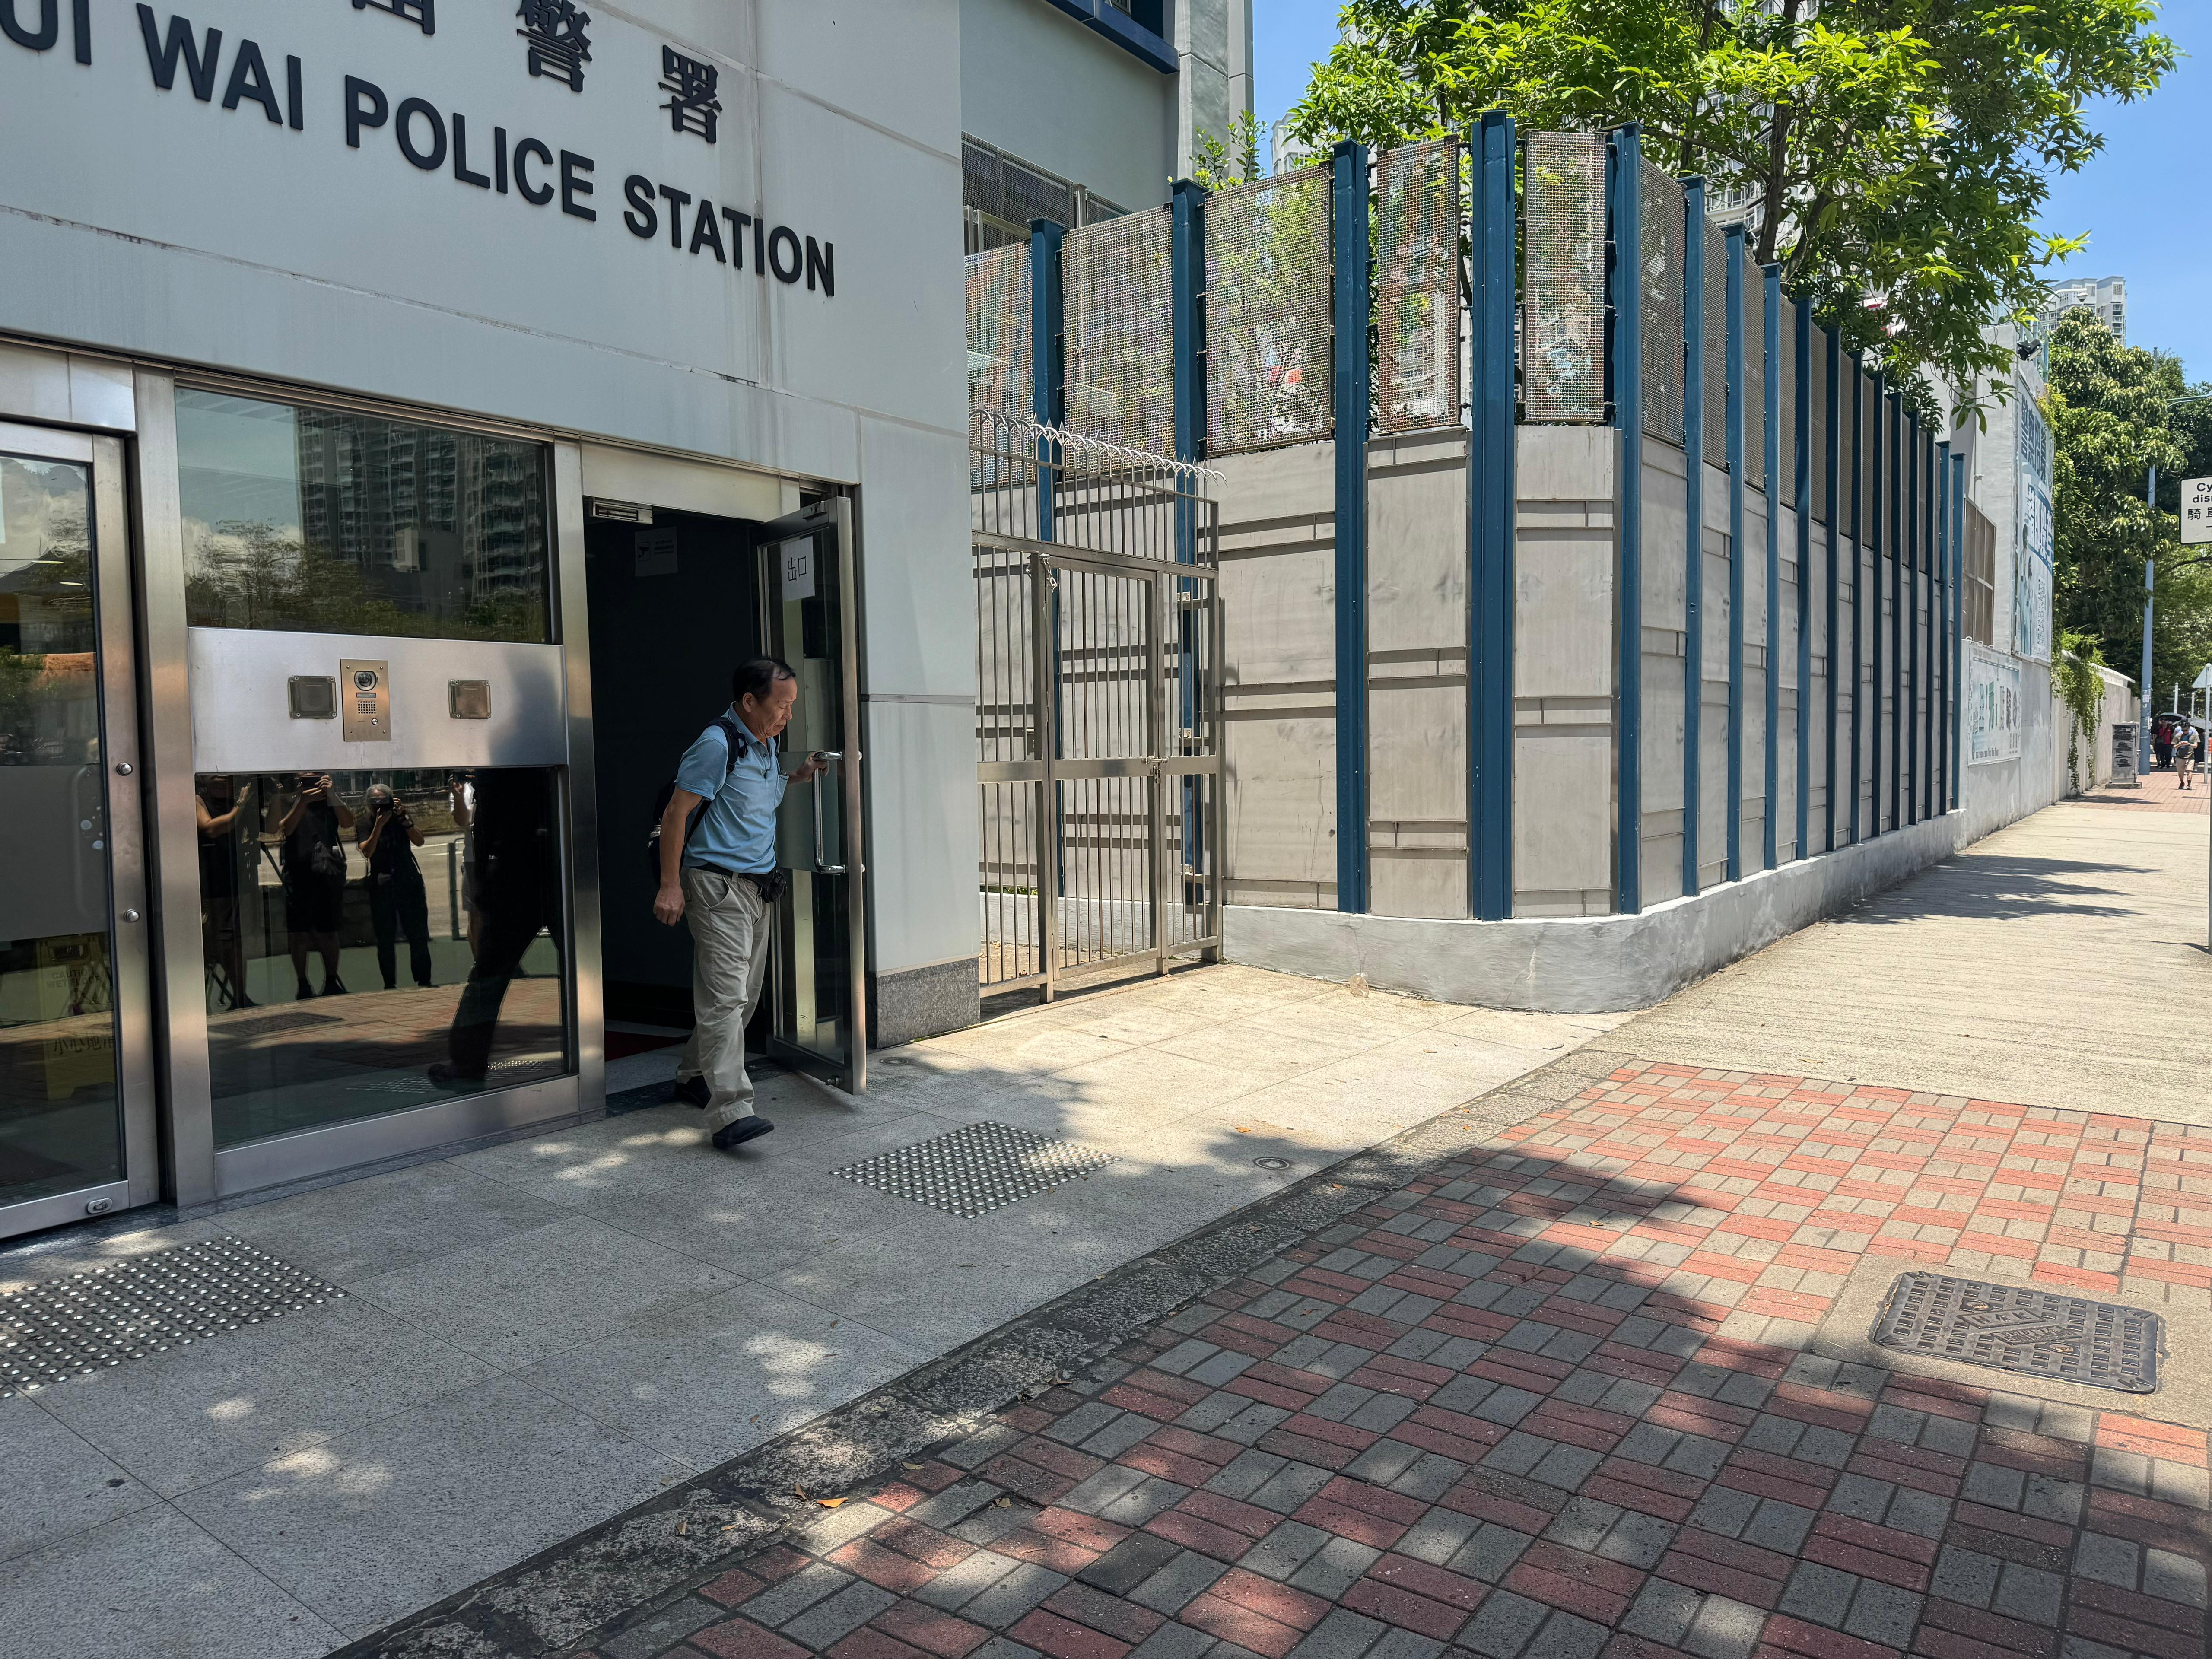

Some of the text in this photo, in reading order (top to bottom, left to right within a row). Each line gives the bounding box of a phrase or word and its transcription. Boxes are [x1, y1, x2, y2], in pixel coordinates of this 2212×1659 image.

[137, 2, 303, 130] WAI
[345, 74, 597, 221] POLICE
[624, 174, 835, 297] STATION
[2021, 394, 2047, 485] 警察招募
[2192, 494, 2212, 503] dis
[788, 556, 807, 581] 出口
[46, 979, 67, 989] WET
